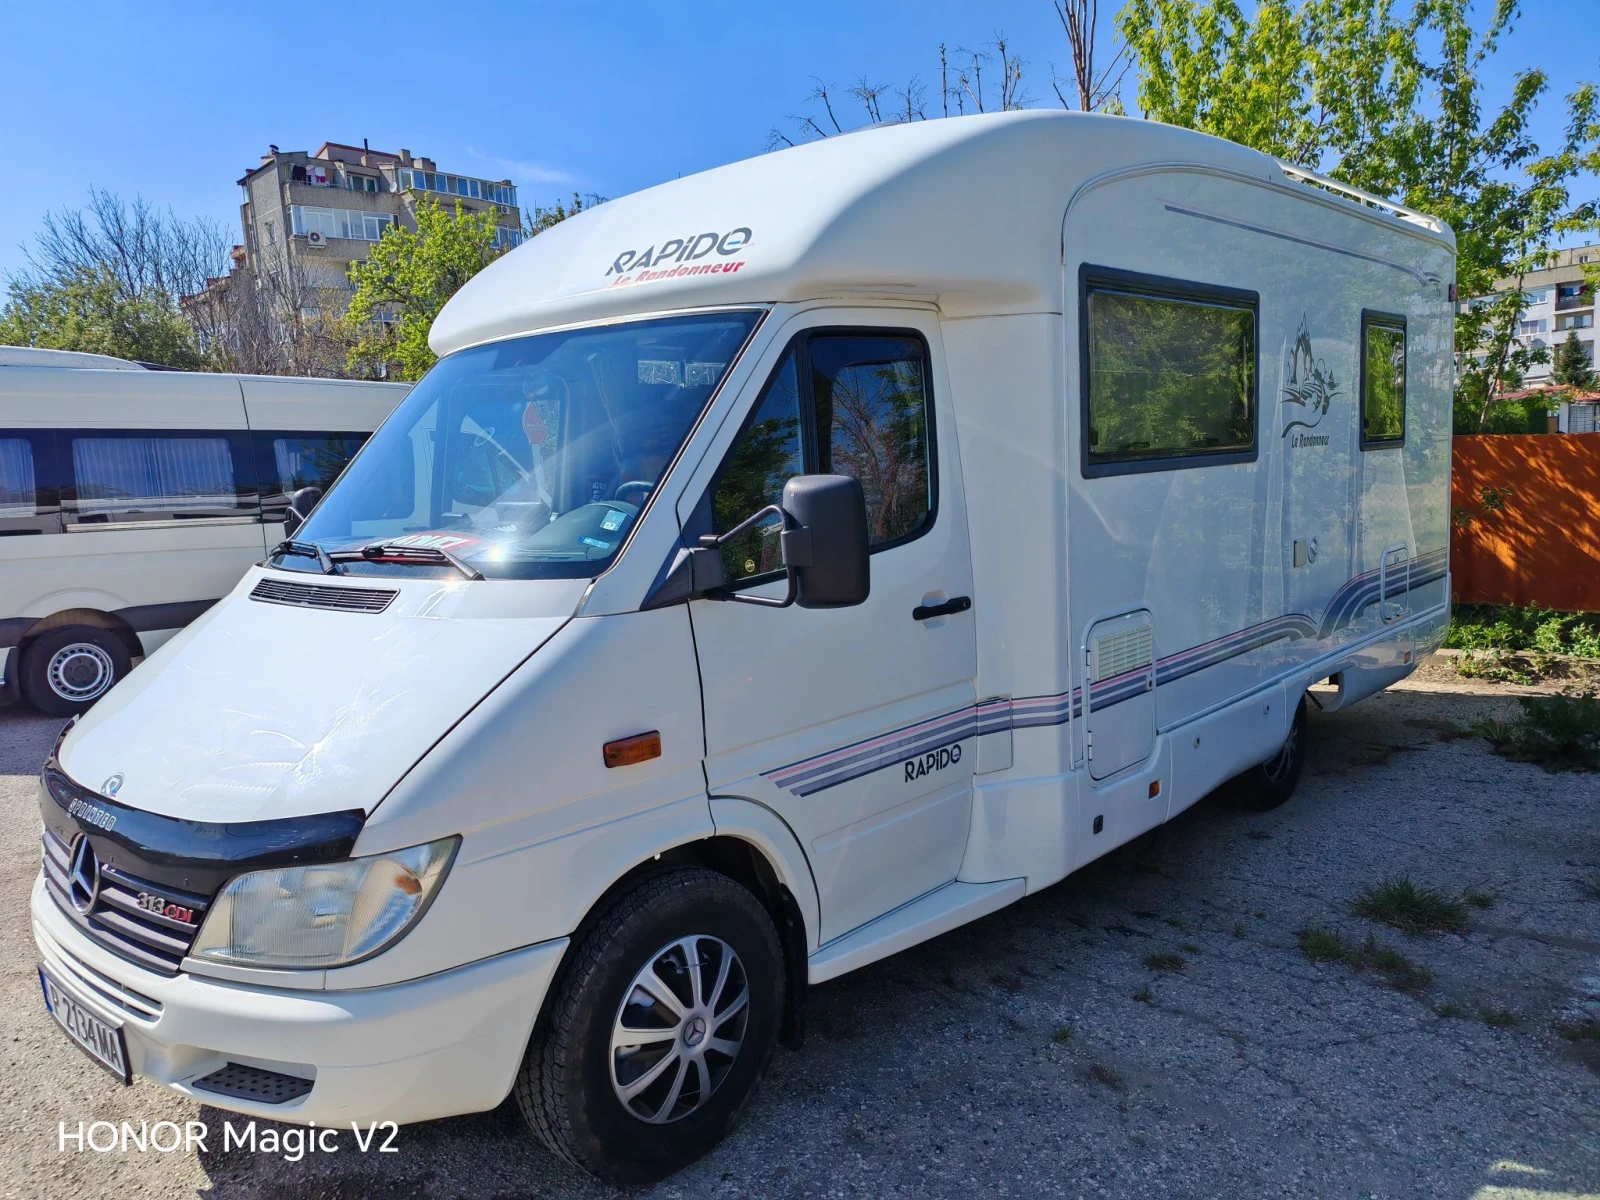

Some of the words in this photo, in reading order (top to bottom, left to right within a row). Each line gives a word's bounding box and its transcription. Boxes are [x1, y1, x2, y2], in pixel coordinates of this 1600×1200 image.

[612, 275, 632, 286] Le
[635, 261, 745, 282] Randonneur
[1291, 434, 1298, 448] Le
[1299, 433, 1330, 448] Randonneur
[69, 798, 116, 832] SPRINTER
[164, 904, 194, 923] CDI
